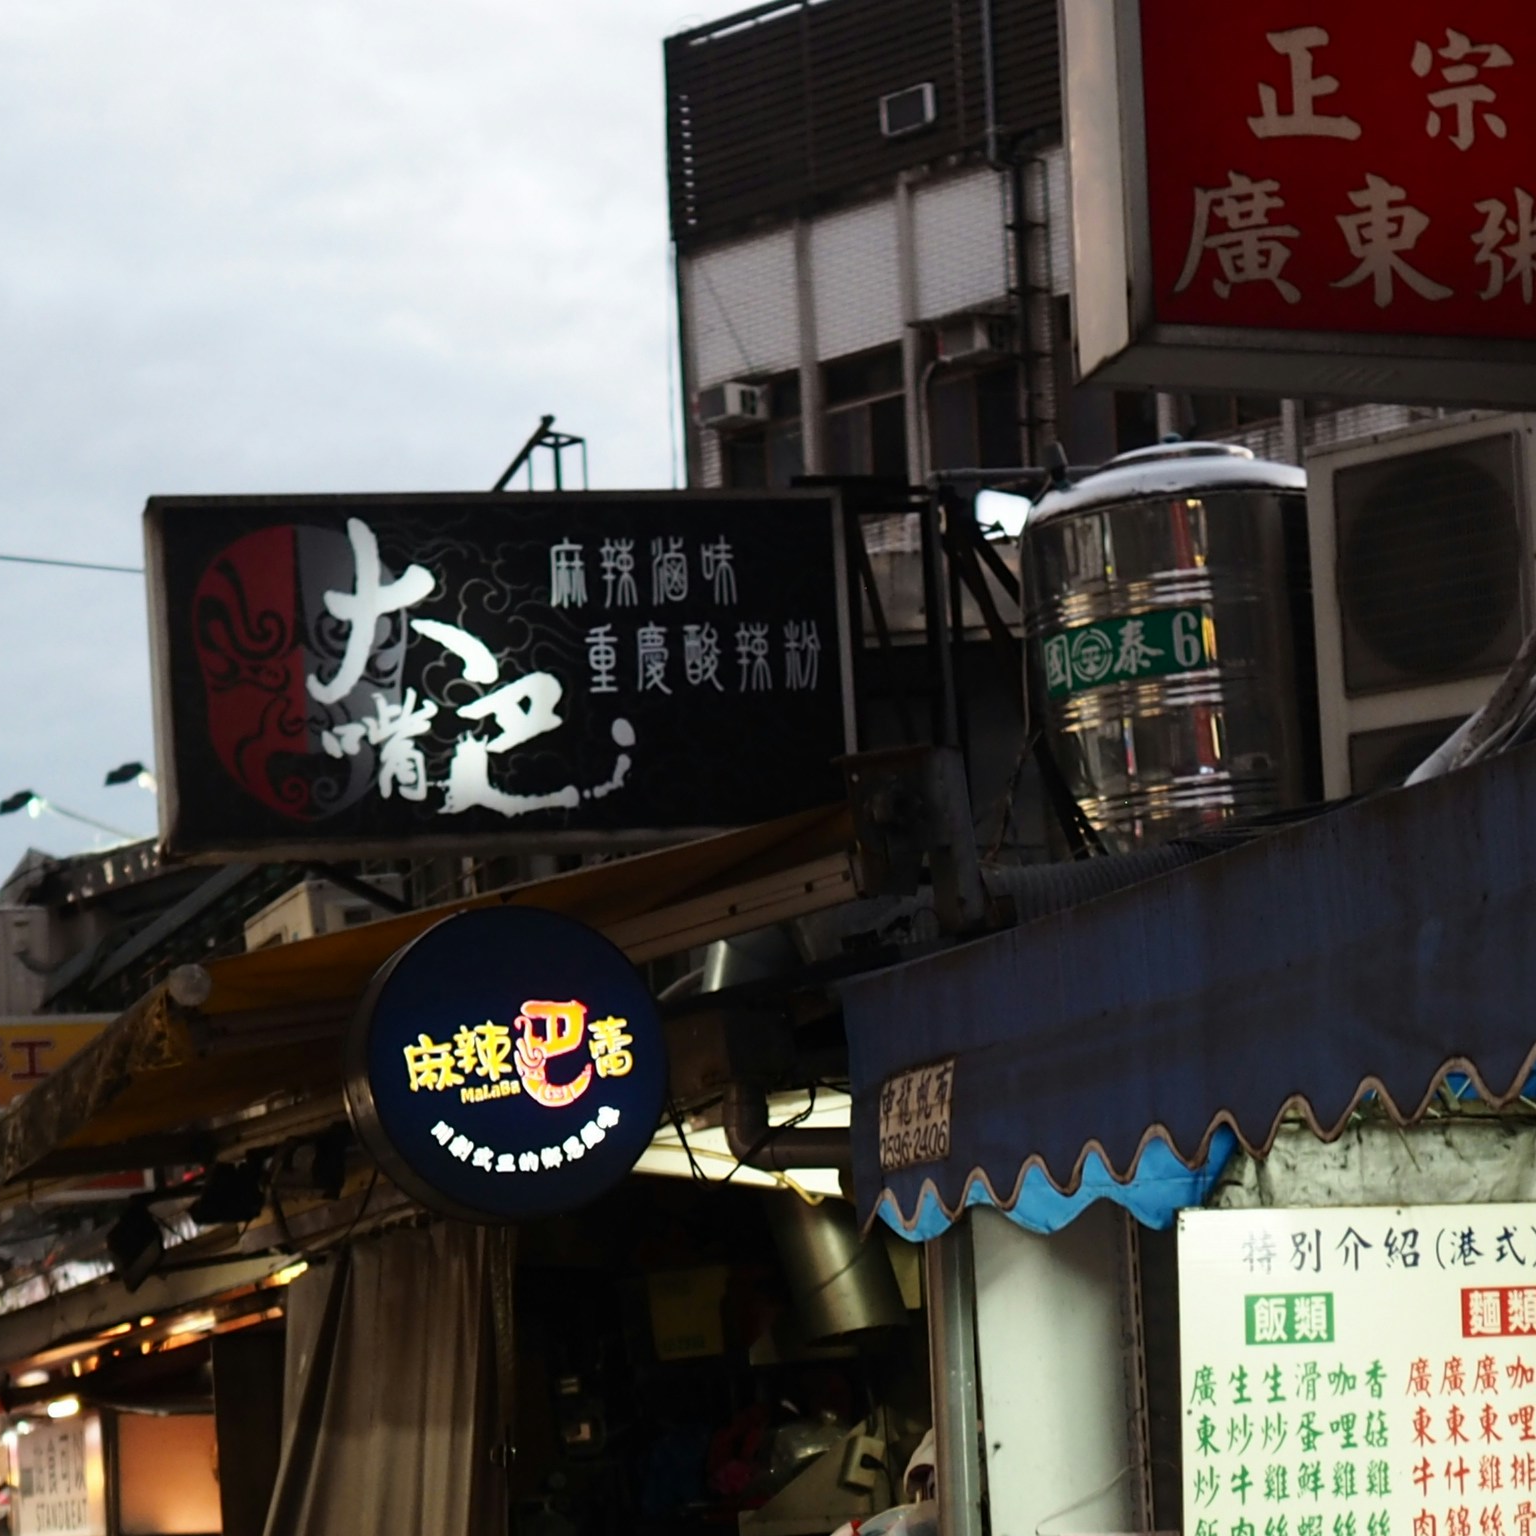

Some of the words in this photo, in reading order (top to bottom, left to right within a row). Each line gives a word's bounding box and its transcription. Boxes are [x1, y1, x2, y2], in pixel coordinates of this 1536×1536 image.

[1247, 26, 1513, 151] 正宗
[550, 536, 738, 608] 麻辣滷味
[586, 622, 821, 694] 重慶酸辣粉
[1253, 1295, 1328, 1343] 飯類
